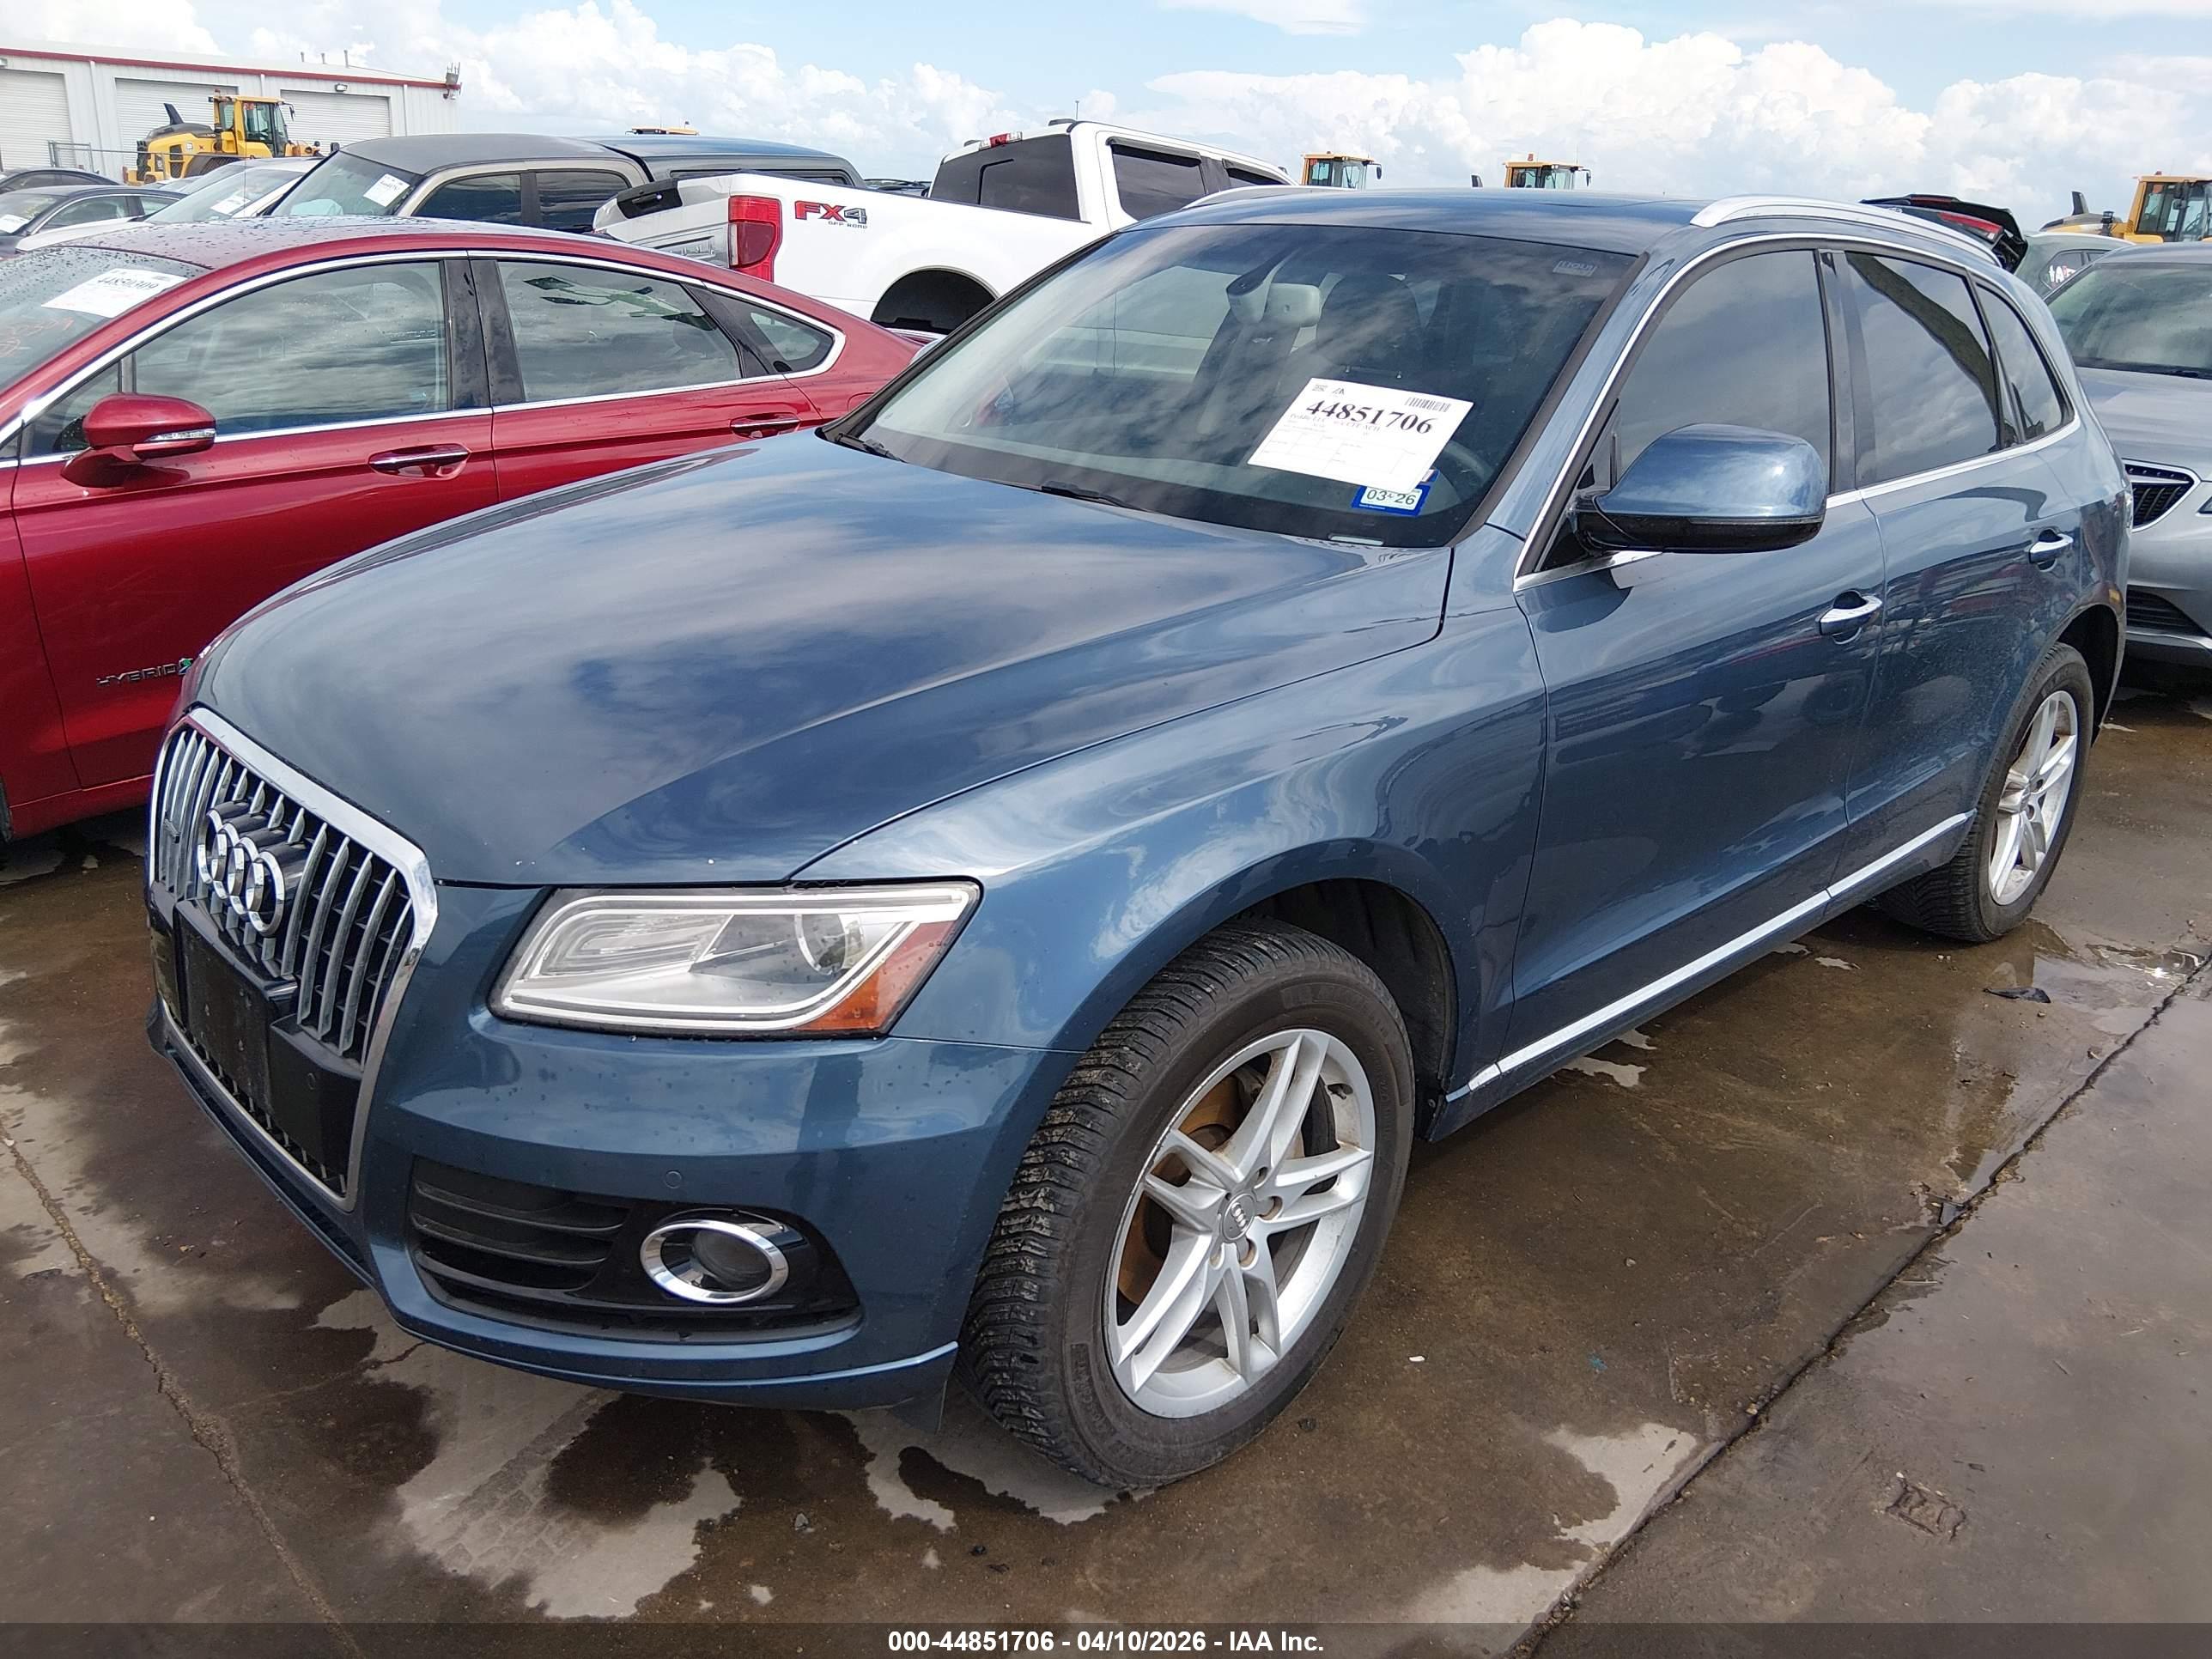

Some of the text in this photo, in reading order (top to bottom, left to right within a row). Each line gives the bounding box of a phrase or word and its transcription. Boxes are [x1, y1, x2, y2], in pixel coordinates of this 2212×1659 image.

[794, 200, 867, 224] FX4
[1306, 400, 1437, 434] 44851706
[96, 663, 177, 686] HYBRID
